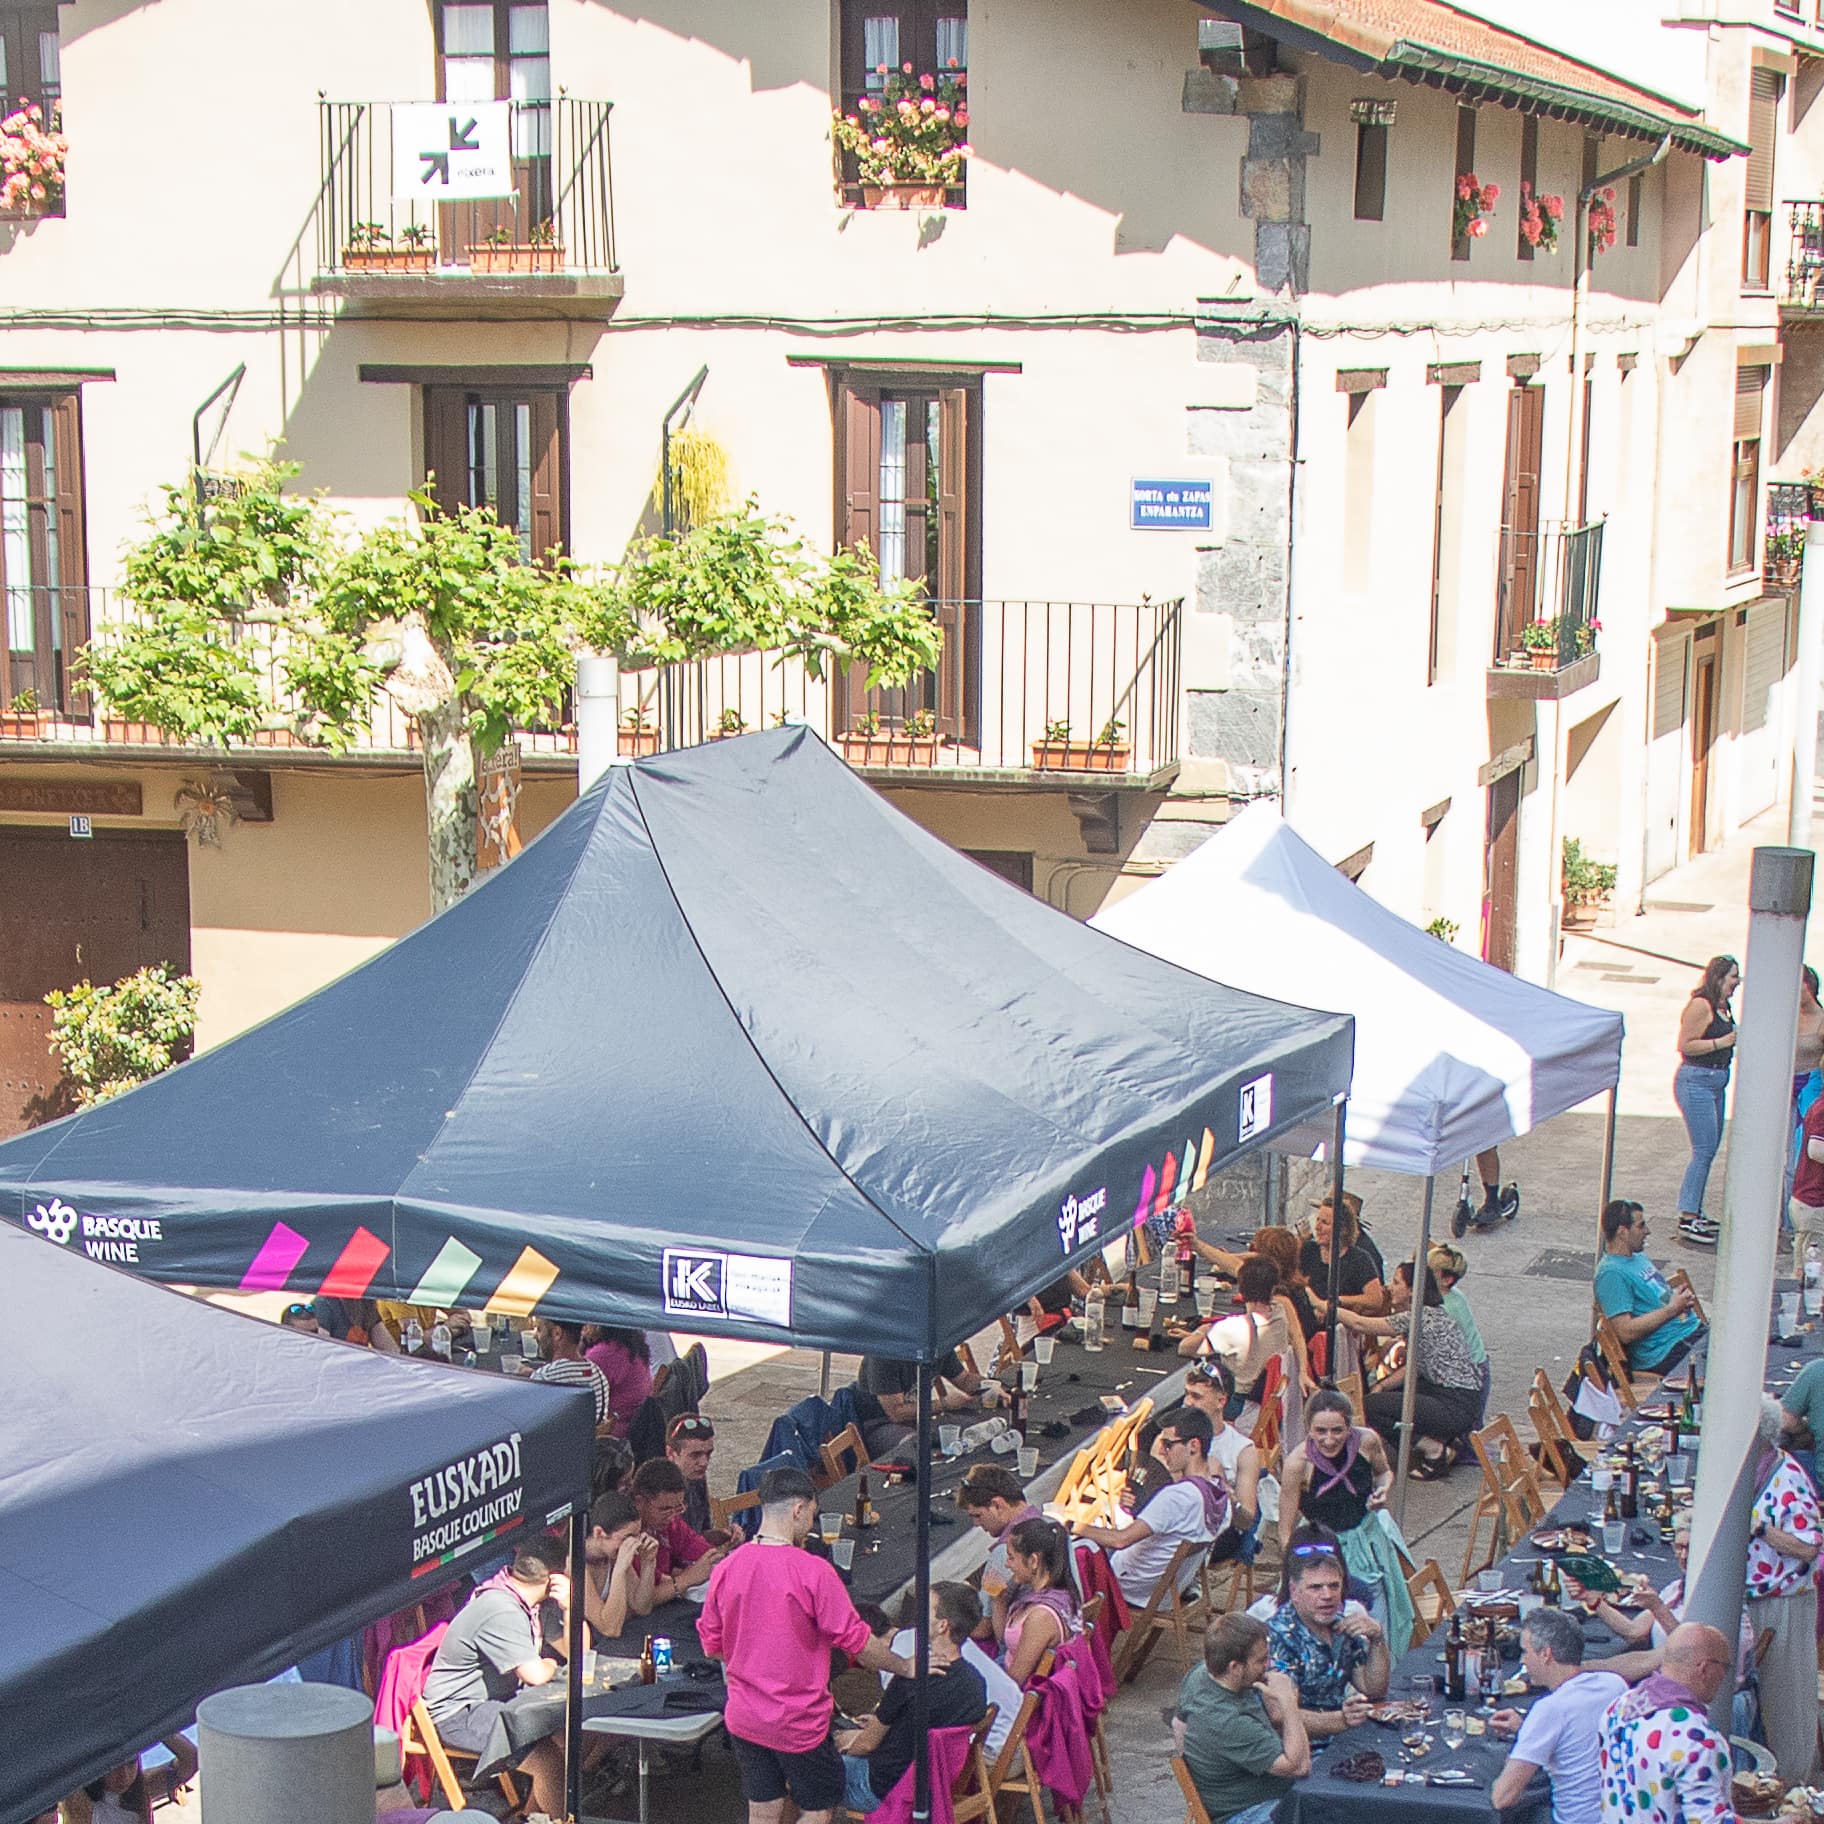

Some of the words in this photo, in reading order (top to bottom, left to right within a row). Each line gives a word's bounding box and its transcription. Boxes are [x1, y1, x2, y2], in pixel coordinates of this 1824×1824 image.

[82, 1216, 162, 1240] BASQUE
[85, 1241, 139, 1263] WINE
[410, 1432, 523, 1528] EUSKADI
[413, 1520, 461, 1561] BASQUE
[462, 1487, 524, 1540] COUNTRY
